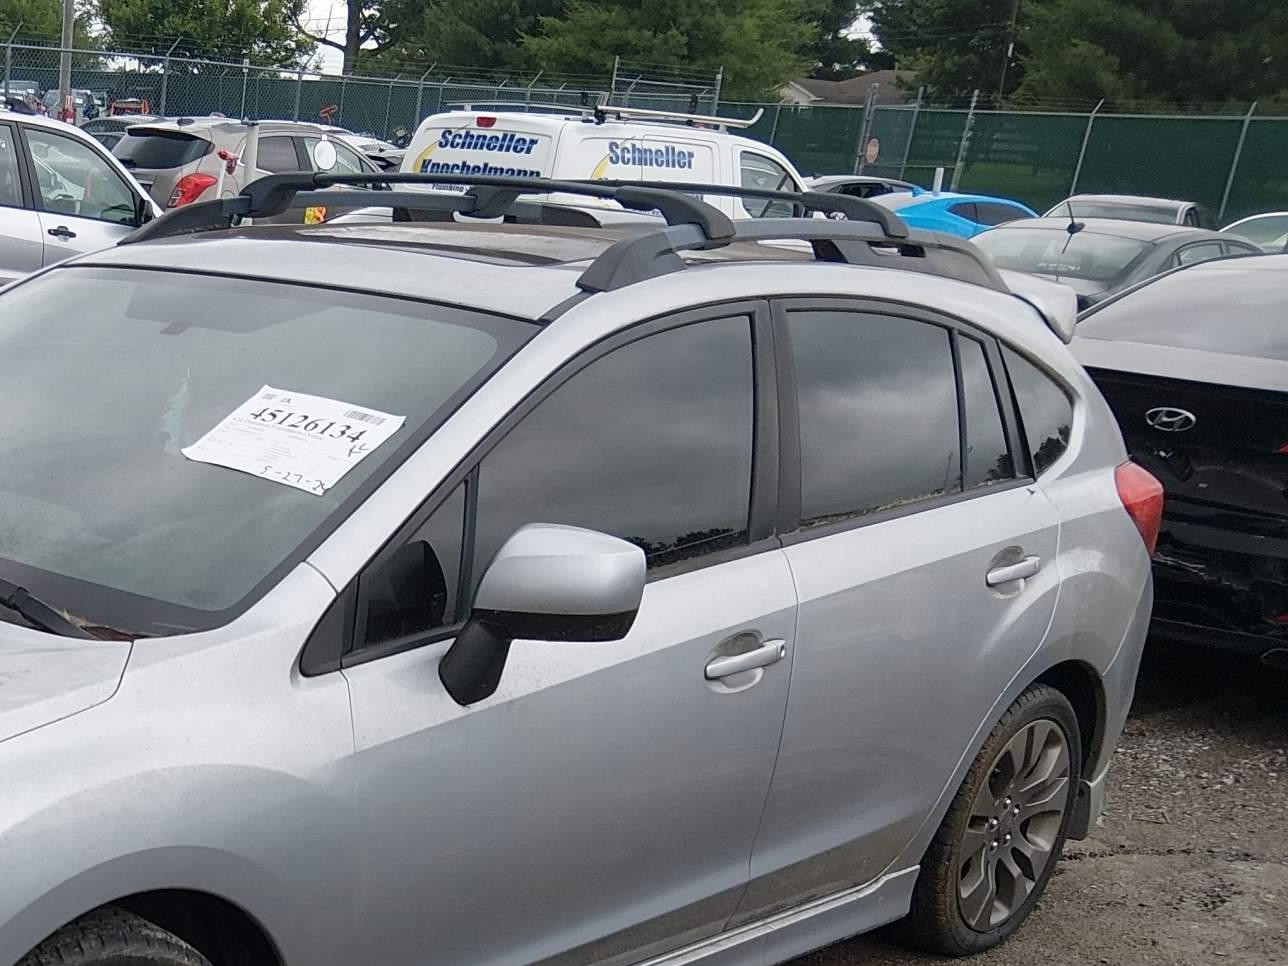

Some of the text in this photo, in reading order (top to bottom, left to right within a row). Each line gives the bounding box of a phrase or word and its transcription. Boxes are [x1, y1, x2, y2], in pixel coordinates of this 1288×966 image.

[438, 130, 538, 154] Schneller
[608, 141, 694, 169] Schneller
[249, 407, 368, 443] 45126134
